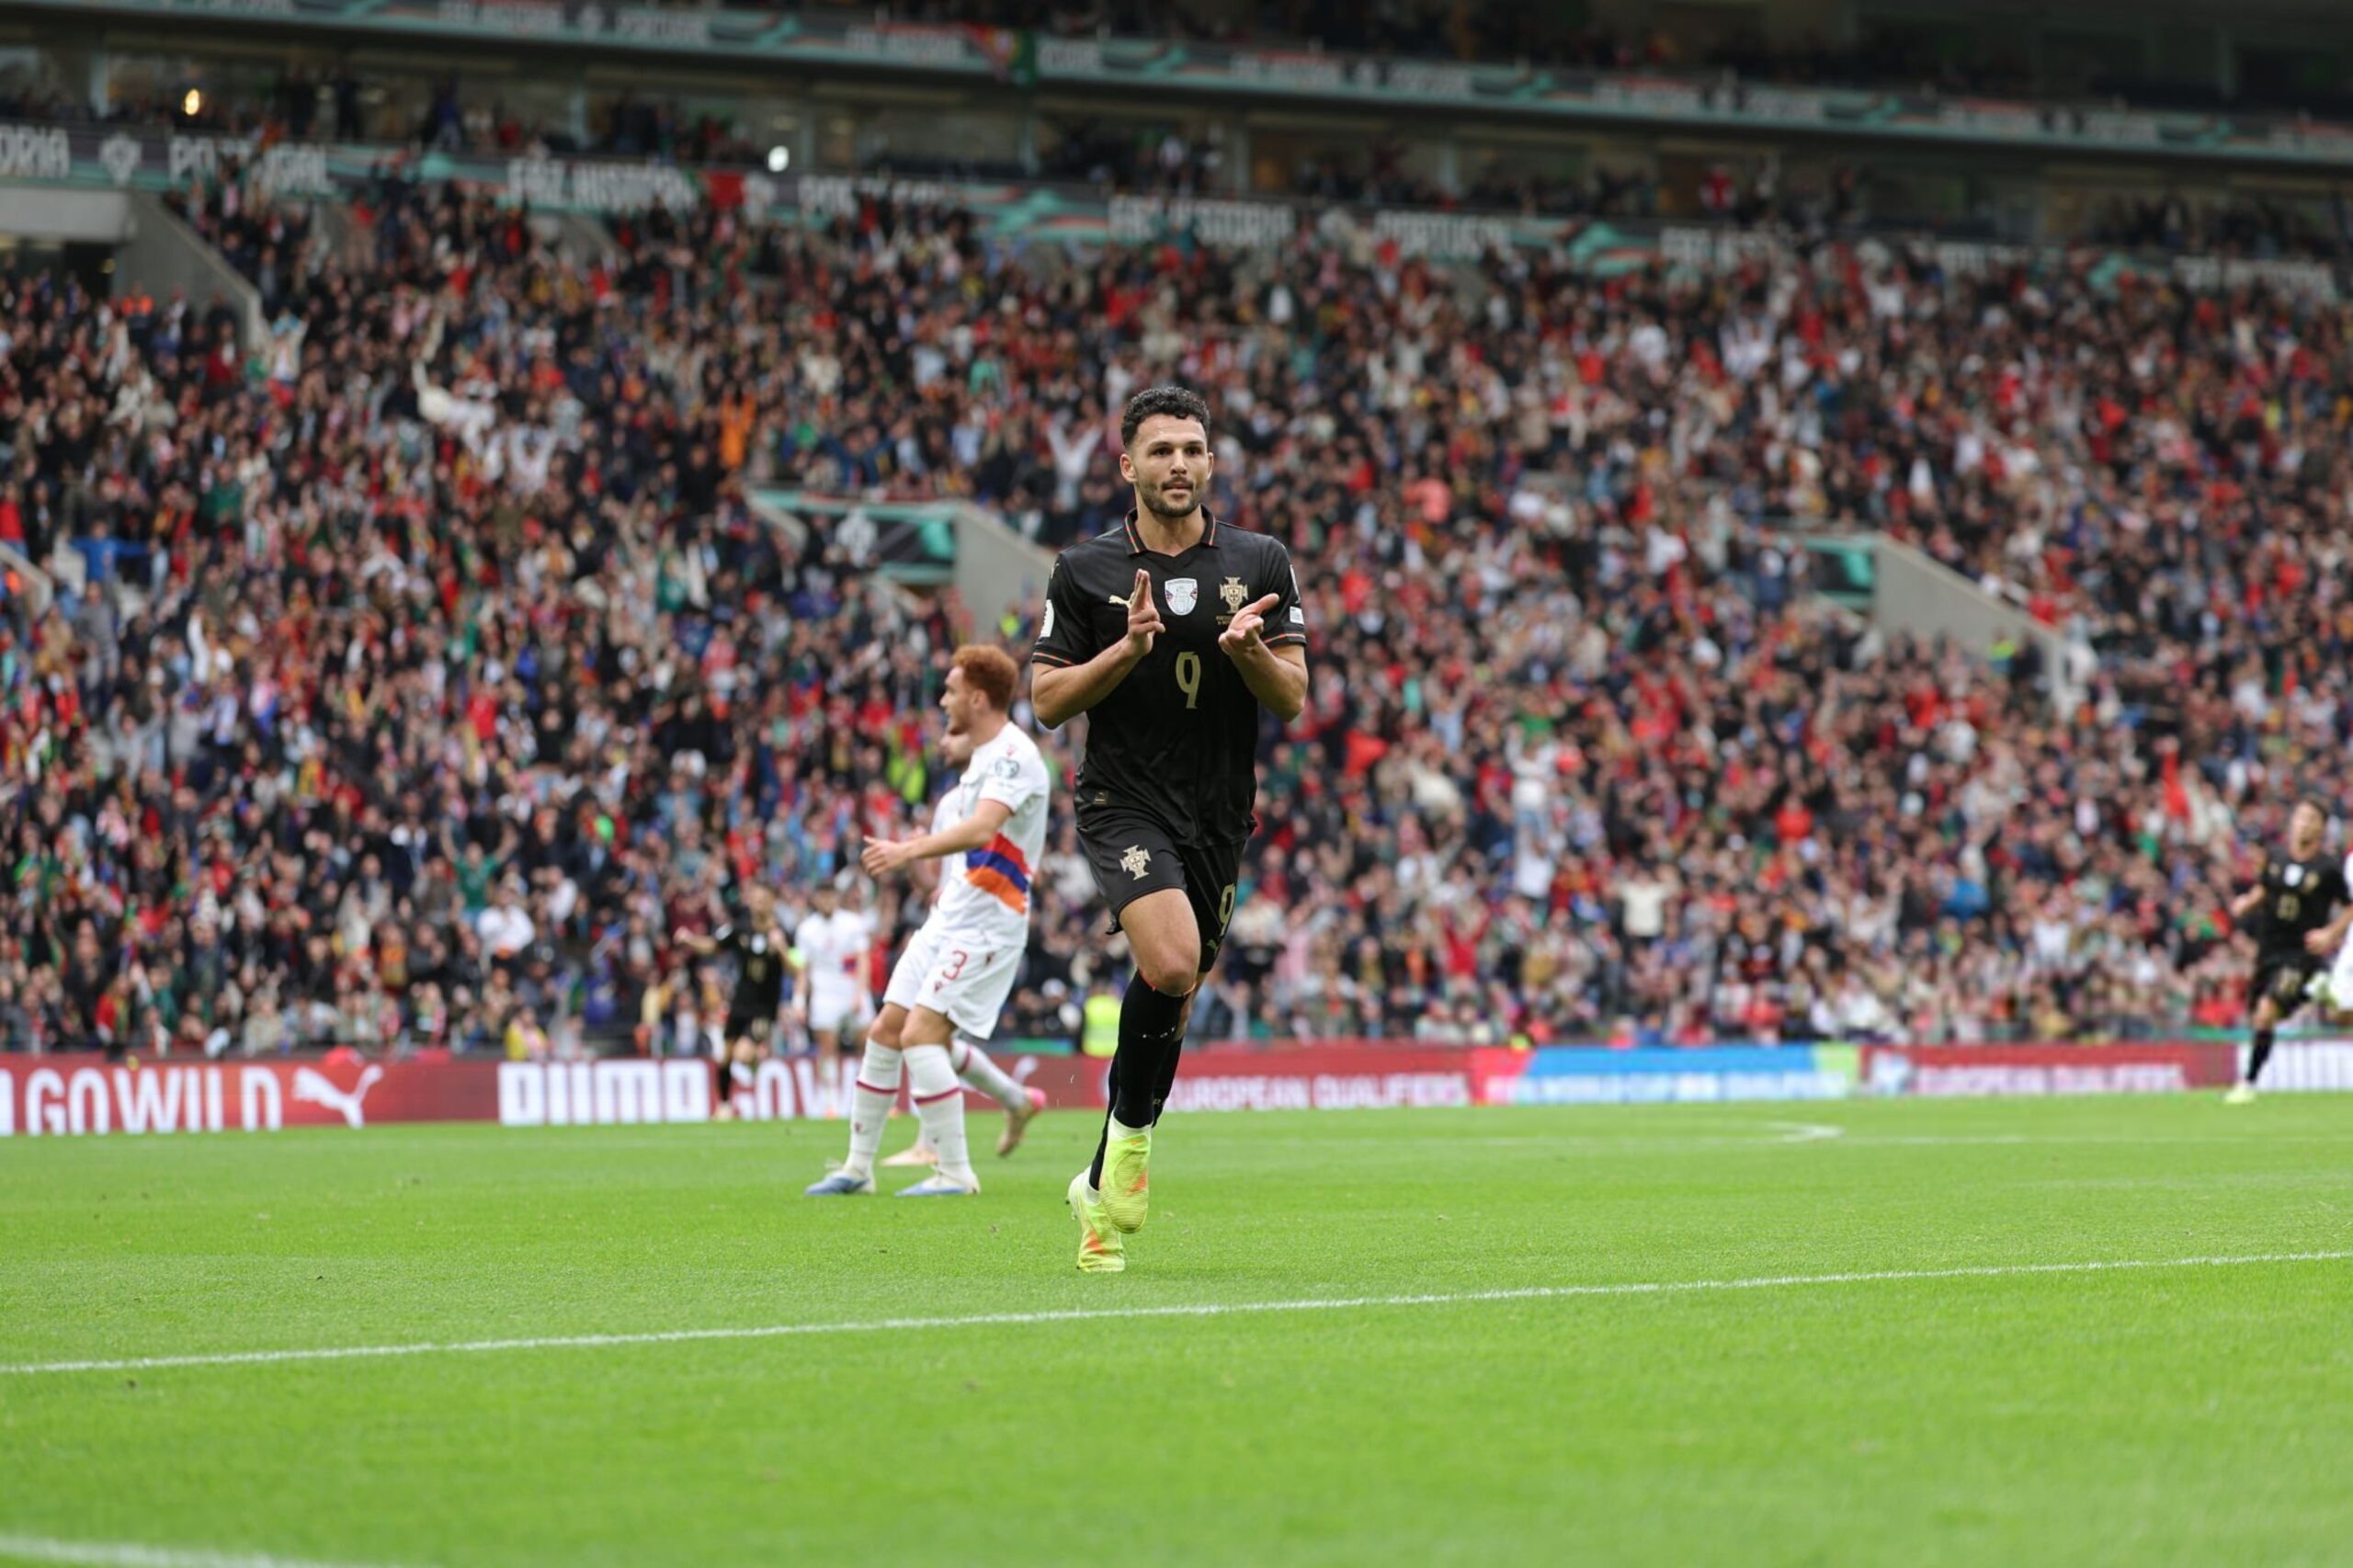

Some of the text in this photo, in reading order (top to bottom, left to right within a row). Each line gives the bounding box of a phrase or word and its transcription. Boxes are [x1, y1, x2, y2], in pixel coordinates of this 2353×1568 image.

[1176, 652, 1201, 710] 9
[1218, 883, 1236, 935] 9
[942, 950, 968, 981] 3
[1164, 1074, 1310, 1112] UROPEAN
